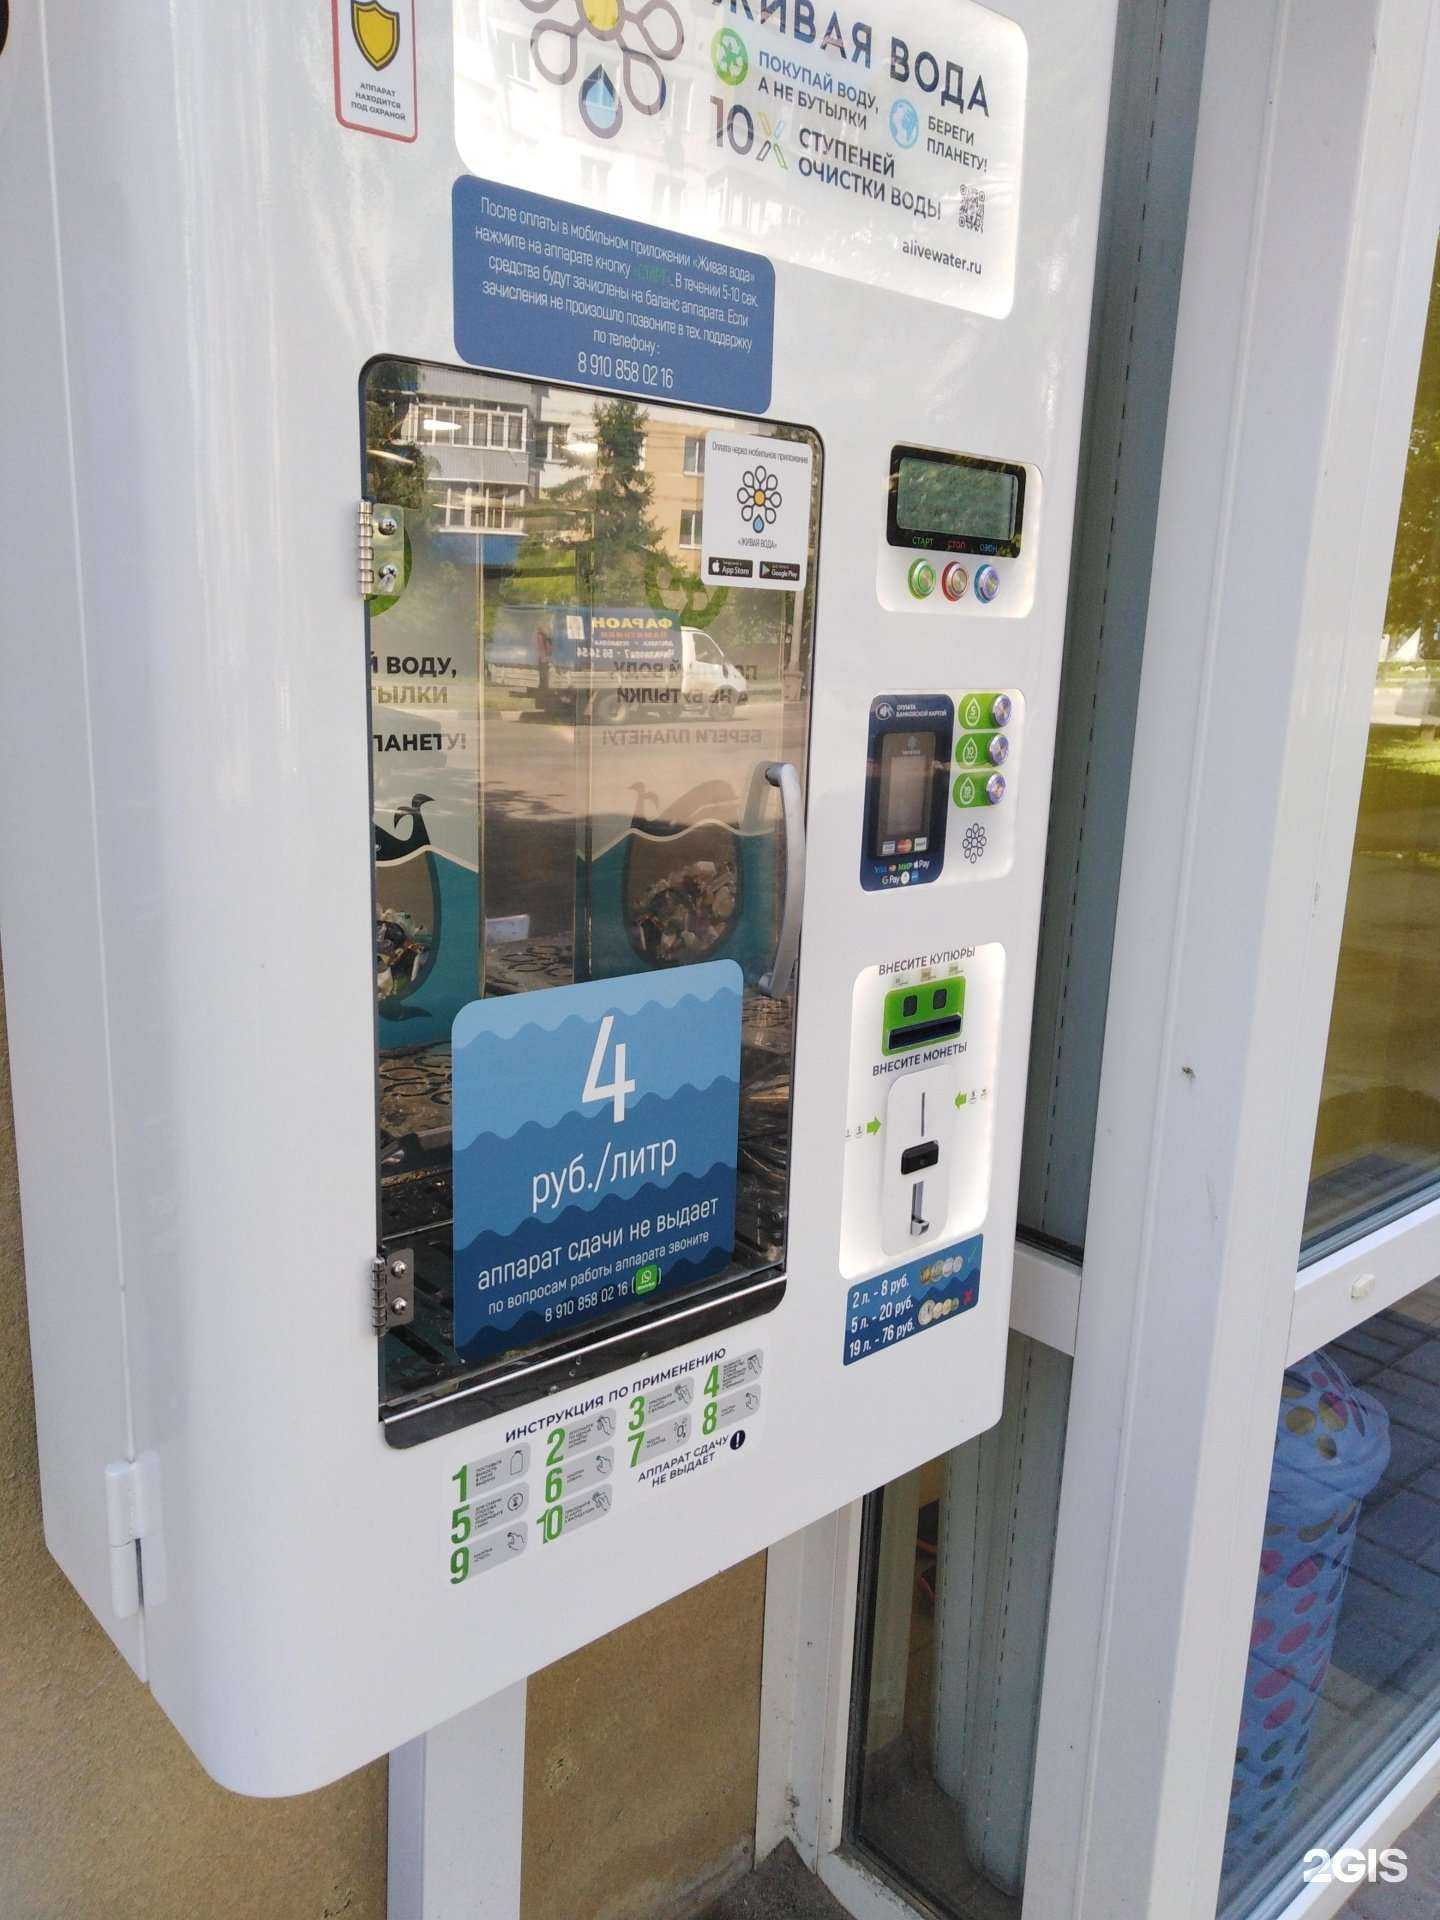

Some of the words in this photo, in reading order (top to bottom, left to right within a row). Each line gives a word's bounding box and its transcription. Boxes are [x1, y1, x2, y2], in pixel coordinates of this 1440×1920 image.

[360, 82, 396, 97] АППАРАТ
[759, 50, 833, 94] ПОКУПАЙ
[838, 83, 879, 112] ВОДУ,
[890, 36, 989, 117] ВОДА
[351, 101, 368, 112] ПОД
[369, 106, 406, 120] ОХРАНОЙ
[355, 92, 401, 109] НАХОДИТСЯ
[758, 80, 768, 94] А
[774, 83, 793, 103] НЕ
[798, 90, 867, 130] БУТЫЛКИ
[927, 115, 975, 146] БЕРЕГИ
[799, 127, 895, 178] СТУПЕНЕЙ
[927, 137, 988, 172] ПЛАНЕТУ!
[799, 156, 885, 201] ОЧИСТКИ
[891, 187, 941, 220] ВОДЫ
[481, 196, 516, 222] После
[519, 207, 561, 232] оплаты
[562, 223, 569, 235] в
[570, 224, 629, 250] мобильном
[630, 240, 690, 266] приложении
[475, 226, 526, 250] нажмите
[528, 240, 542, 254] на
[544, 244, 593, 267] аппарате
[595, 257, 631, 279] кнопку
[675, 272, 682, 287] В
[683, 276, 721, 299] течении
[722, 285, 740, 302] 5-10
[902, 239, 982, 275] alivewater.ru
[488, 255, 540, 279] средства
[542, 265, 571, 288] будут
[573, 275, 629, 300] зачислены
[631, 290, 643, 303] на
[645, 289, 679, 311] баланс
[681, 300, 725, 323] аппарата.
[727, 309, 749, 327] Если
[482, 280, 548, 306] зачисления
[550, 296, 563, 309] не
[565, 298, 624, 325] произошло
[626, 311, 676, 335] позвоните
[678, 324, 684, 335] в
[703, 329, 753, 353] поддержку
[593, 328, 607, 343] по
[577, 351, 587, 373] 8
[590, 353, 612, 378] 910
[615, 358, 639, 383] 858
[642, 364, 658, 386] 02
[660, 367, 674, 390] 16
[912, 535, 934, 546] СТАРТ
[722, 566, 734, 576] App
[387, 656, 457, 678] ВОДУ,
[878, 956, 927, 976] ВНЕСИТЕ
[930, 947, 976, 965] КУПЮРЫ
[582, 1015, 636, 1124] 4
[872, 1055, 920, 1076] ВНЕСИТЕ
[923, 1042, 968, 1062] МОНЕТЫ
[532, 1137, 678, 1213] руб./литр
[478, 1246, 562, 1290] аппарат
[568, 1226, 623, 1264] сдачи
[630, 1216, 651, 1240] не
[656, 1197, 719, 1232] выдает
[488, 1299, 504, 1316] по
[507, 1278, 567, 1312] вопросам
[570, 1264, 612, 1292] работы
[615, 1245, 666, 1273] аппарата
[668, 1231, 709, 1255] звоните
[853, 1291, 860, 1309] 2
[861, 1292, 870, 1306] л.
[881, 1279, 888, 1296] 8
[890, 1273, 909, 1295] руб.
[544, 1306, 552, 1322] 8
[556, 1300, 574, 1319] 910
[578, 1292, 598, 1312] 858
[601, 1286, 615, 1303] 02
[617, 1281, 628, 1296] 16
[851, 1316, 858, 1333] 5
[860, 1317, 869, 1331] л.
[879, 1302, 893, 1321] 20
[894, 1295, 913, 1318] руб.
[849, 1339, 861, 1358] 19
[862, 1340, 872, 1352] л.
[882, 1324, 894, 1343] 76
[896, 1318, 915, 1339] руб.
[506, 1395, 604, 1443] ИНСТРУКЦИЯ
[609, 1386, 628, 1403] ПО
[633, 1348, 726, 1393] ПРИМЕНЕНИЮ
[704, 1364, 720, 1398] 4
[628, 1395, 646, 1431] 3
[702, 1401, 718, 1435] 8
[546, 1427, 566, 1467] 2
[627, 1430, 646, 1468] 7
[638, 1452, 691, 1482] АППАРАТ
[693, 1435, 729, 1457] СДАЧУ
[452, 1464, 468, 1502] 1
[545, 1467, 563, 1503] 6
[652, 1473, 667, 1488] НЕ
[670, 1452, 716, 1480] ВЫДАЕТ
[451, 1505, 471, 1544] 5
[536, 1504, 563, 1544] 10
[450, 1546, 470, 1584] 9
